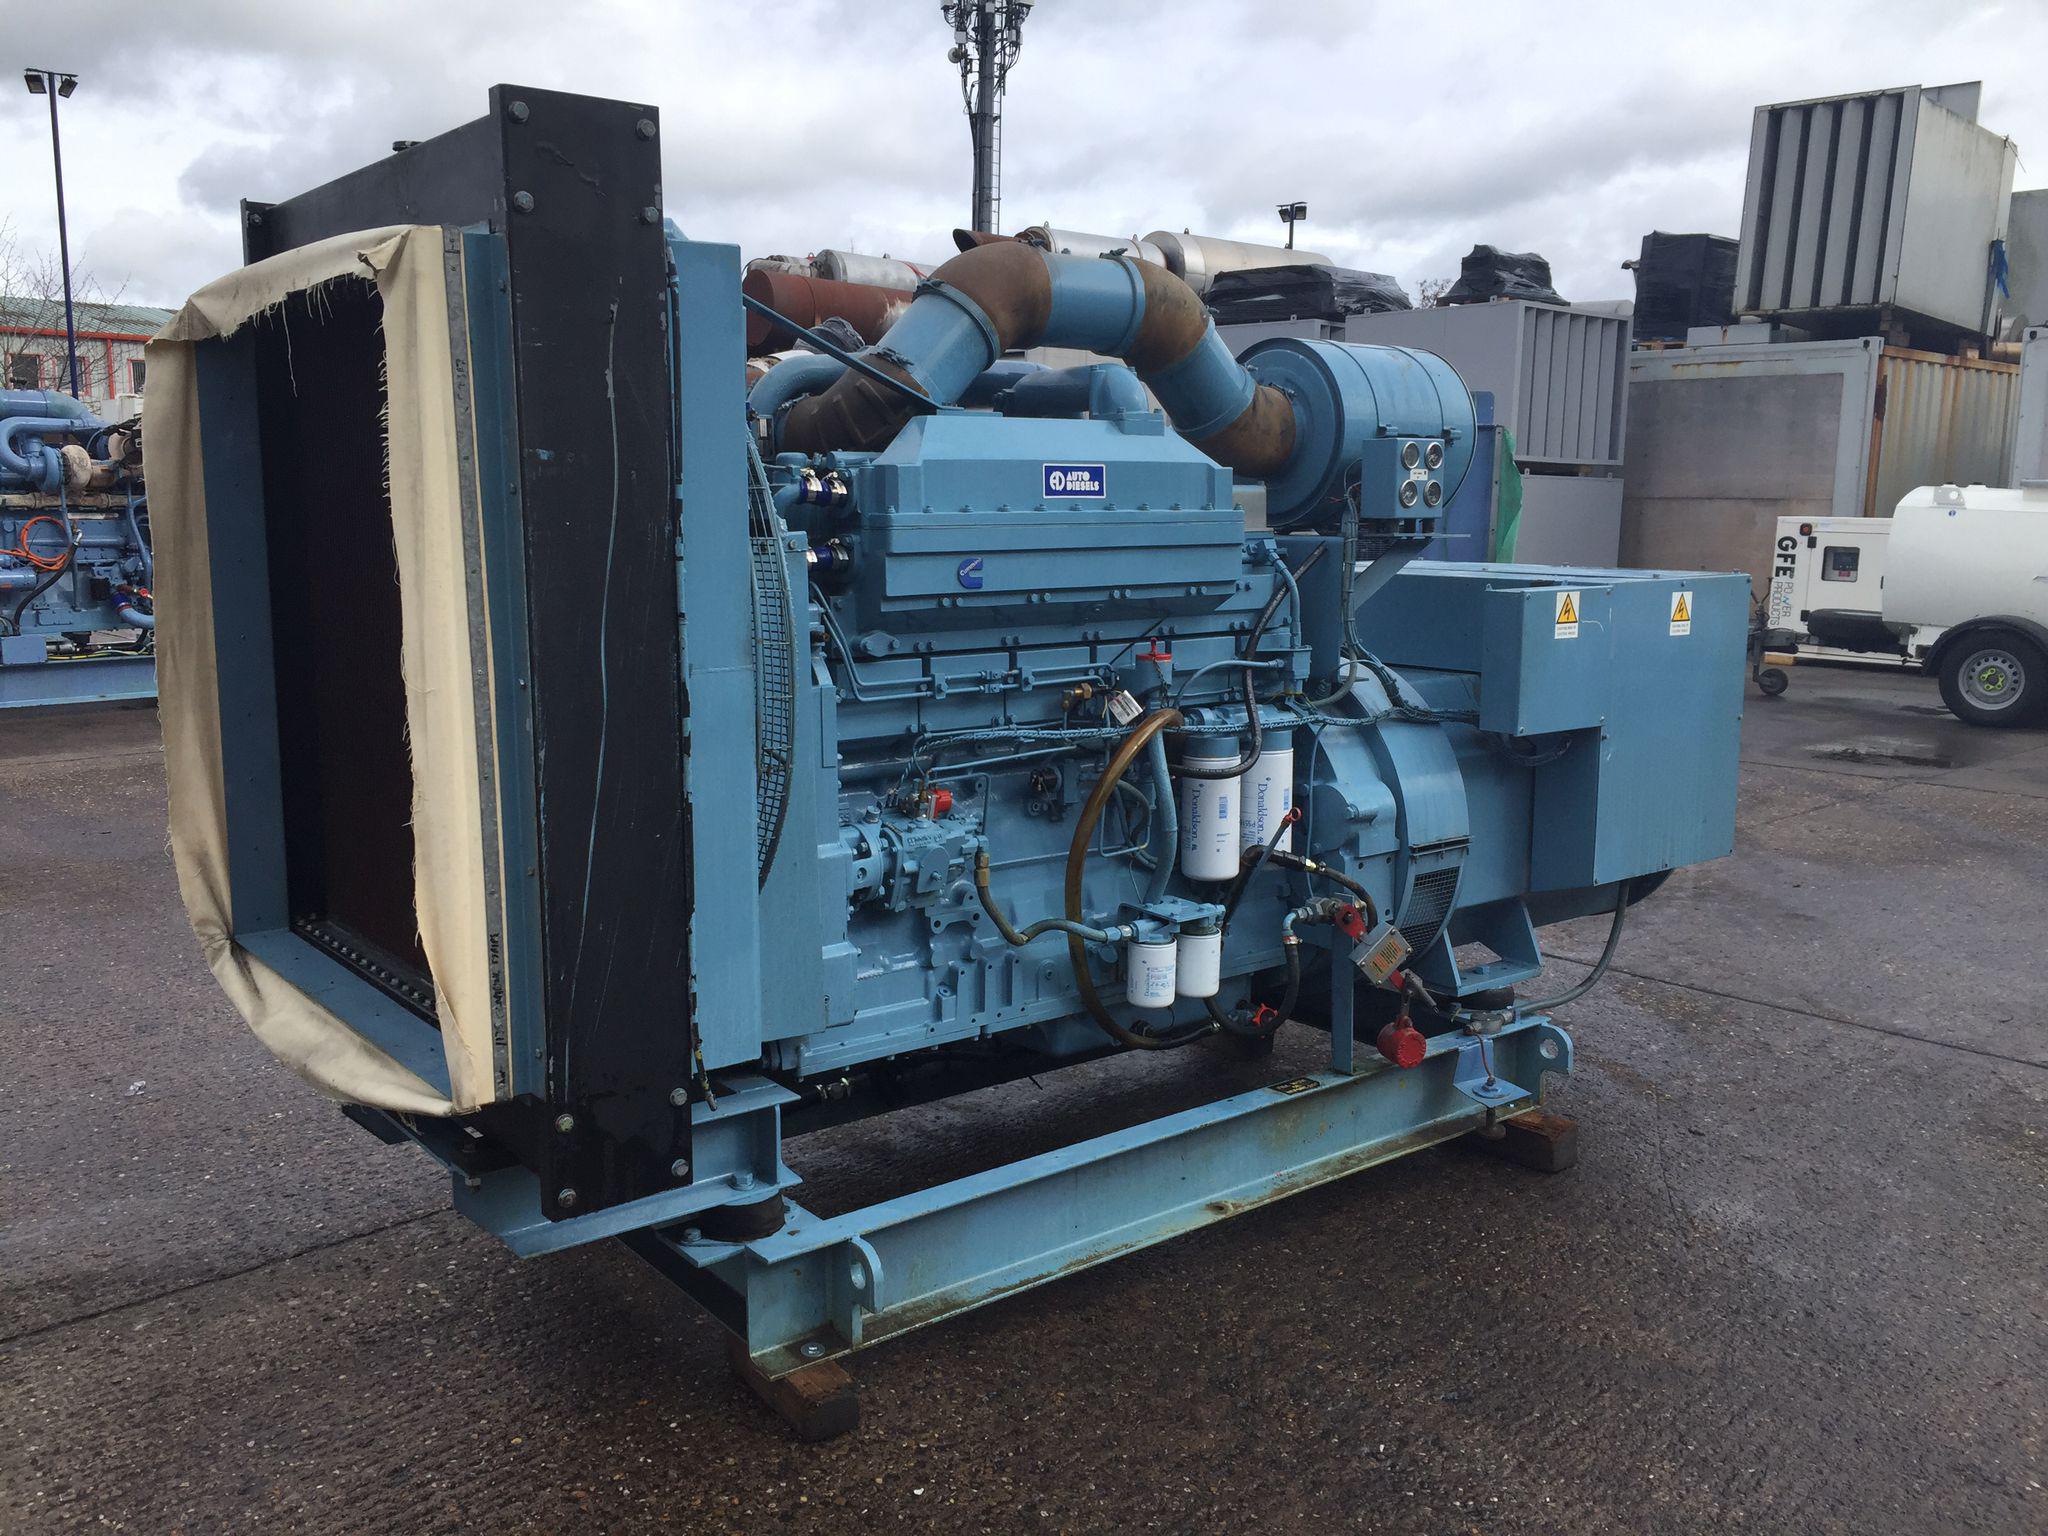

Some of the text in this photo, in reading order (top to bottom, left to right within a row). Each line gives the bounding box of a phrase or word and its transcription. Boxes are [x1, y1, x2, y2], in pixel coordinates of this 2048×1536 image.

[1066, 471, 1091, 481] AUTO
[1066, 481, 1100, 491] DIESELS
[1775, 536, 1798, 579] GFE
[1769, 581, 1783, 626] PRODUCTS
[1781, 581, 1794, 617] POWER
